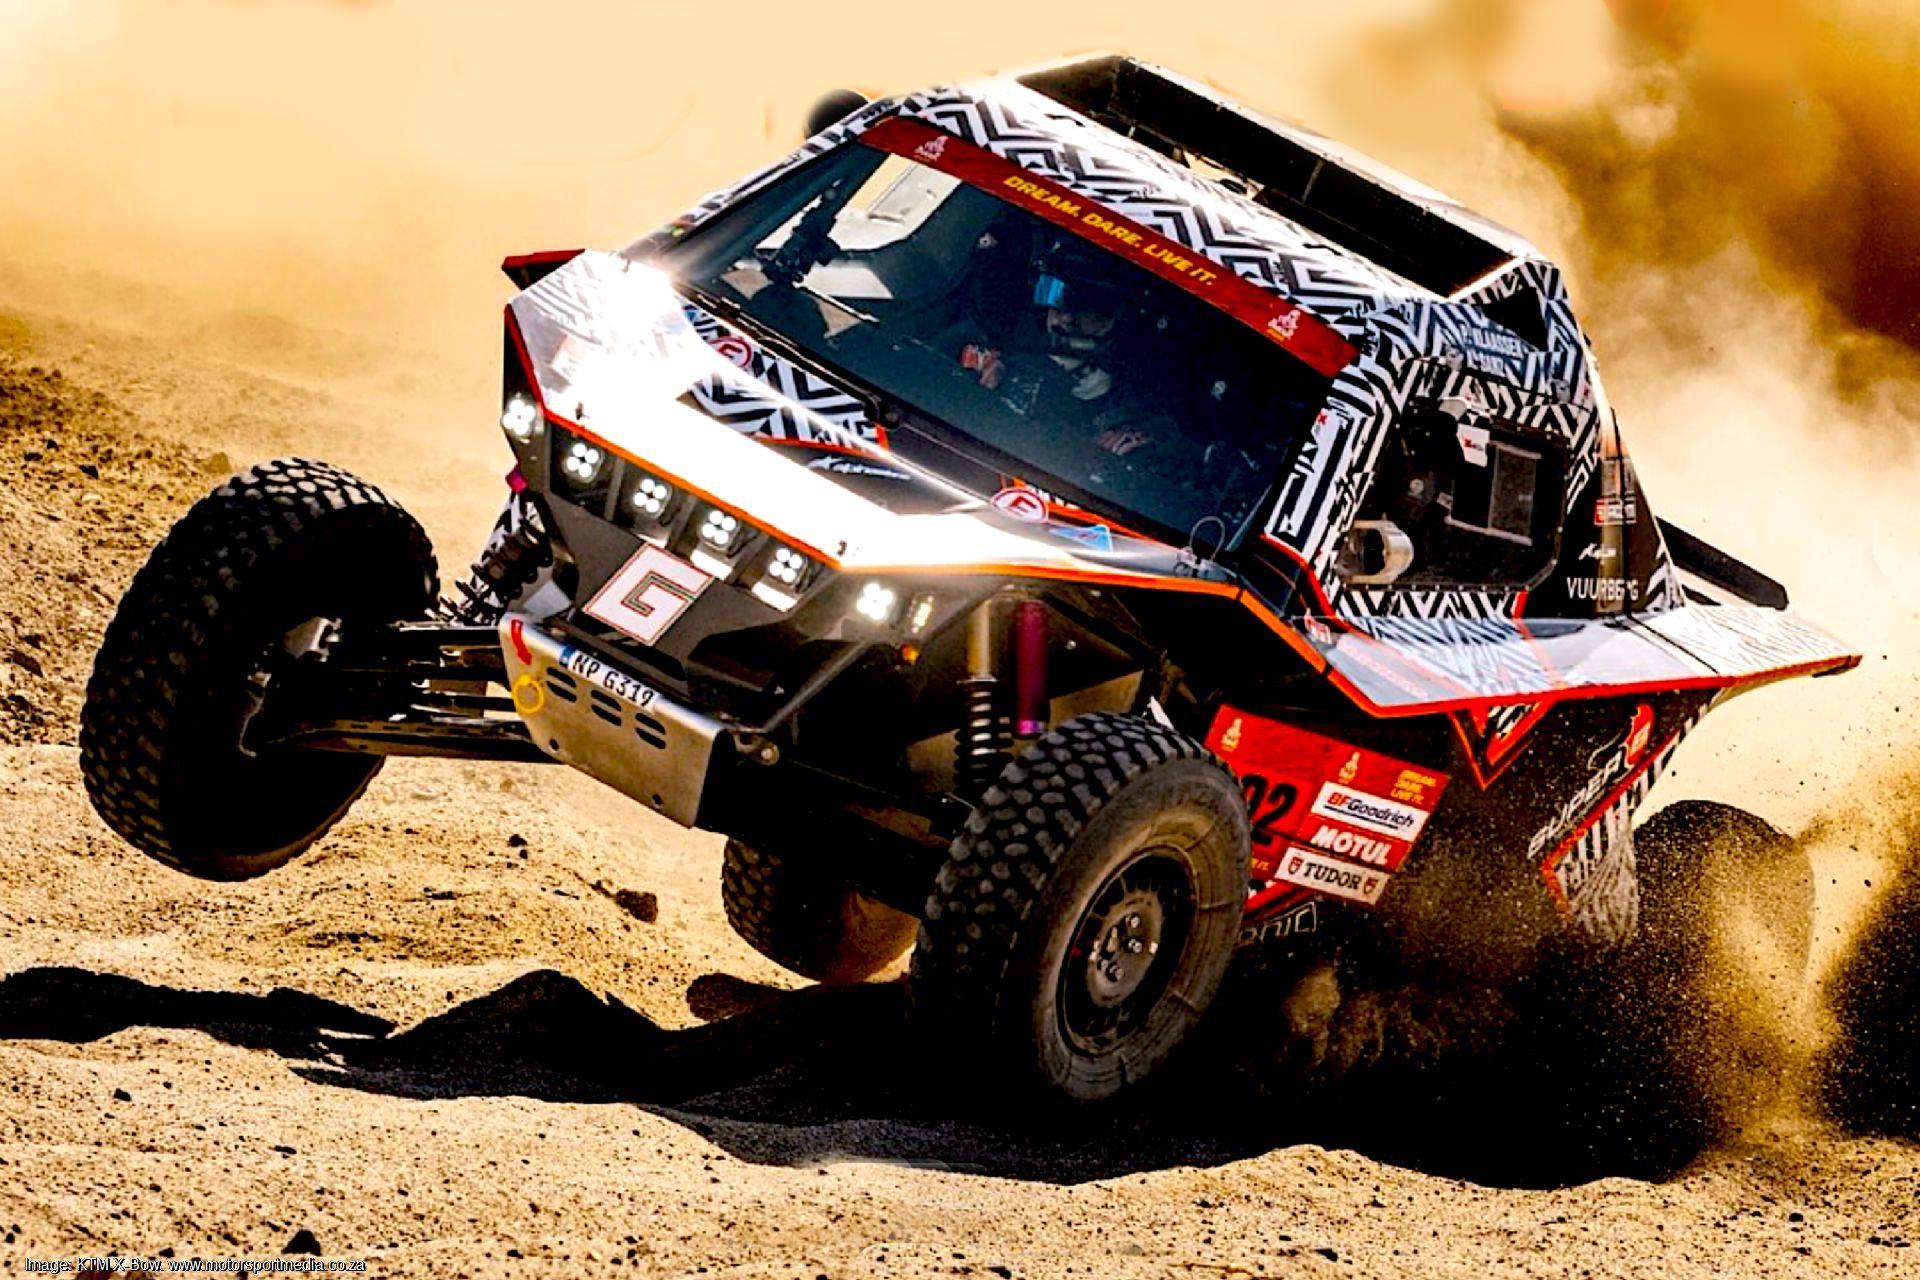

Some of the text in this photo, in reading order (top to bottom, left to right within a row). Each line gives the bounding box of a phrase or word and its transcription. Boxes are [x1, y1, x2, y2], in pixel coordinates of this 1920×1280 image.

[1003, 175, 1217, 286] DREAM. DARE. LIVE IT.
[581, 541, 716, 647] G
[1566, 576, 1640, 601] VUURBEG
[572, 654, 655, 707] NP G319
[1327, 791, 1415, 828] BFGoodrich
[1310, 824, 1392, 865] MOTUL
[1303, 862, 1362, 890] TUDOR
